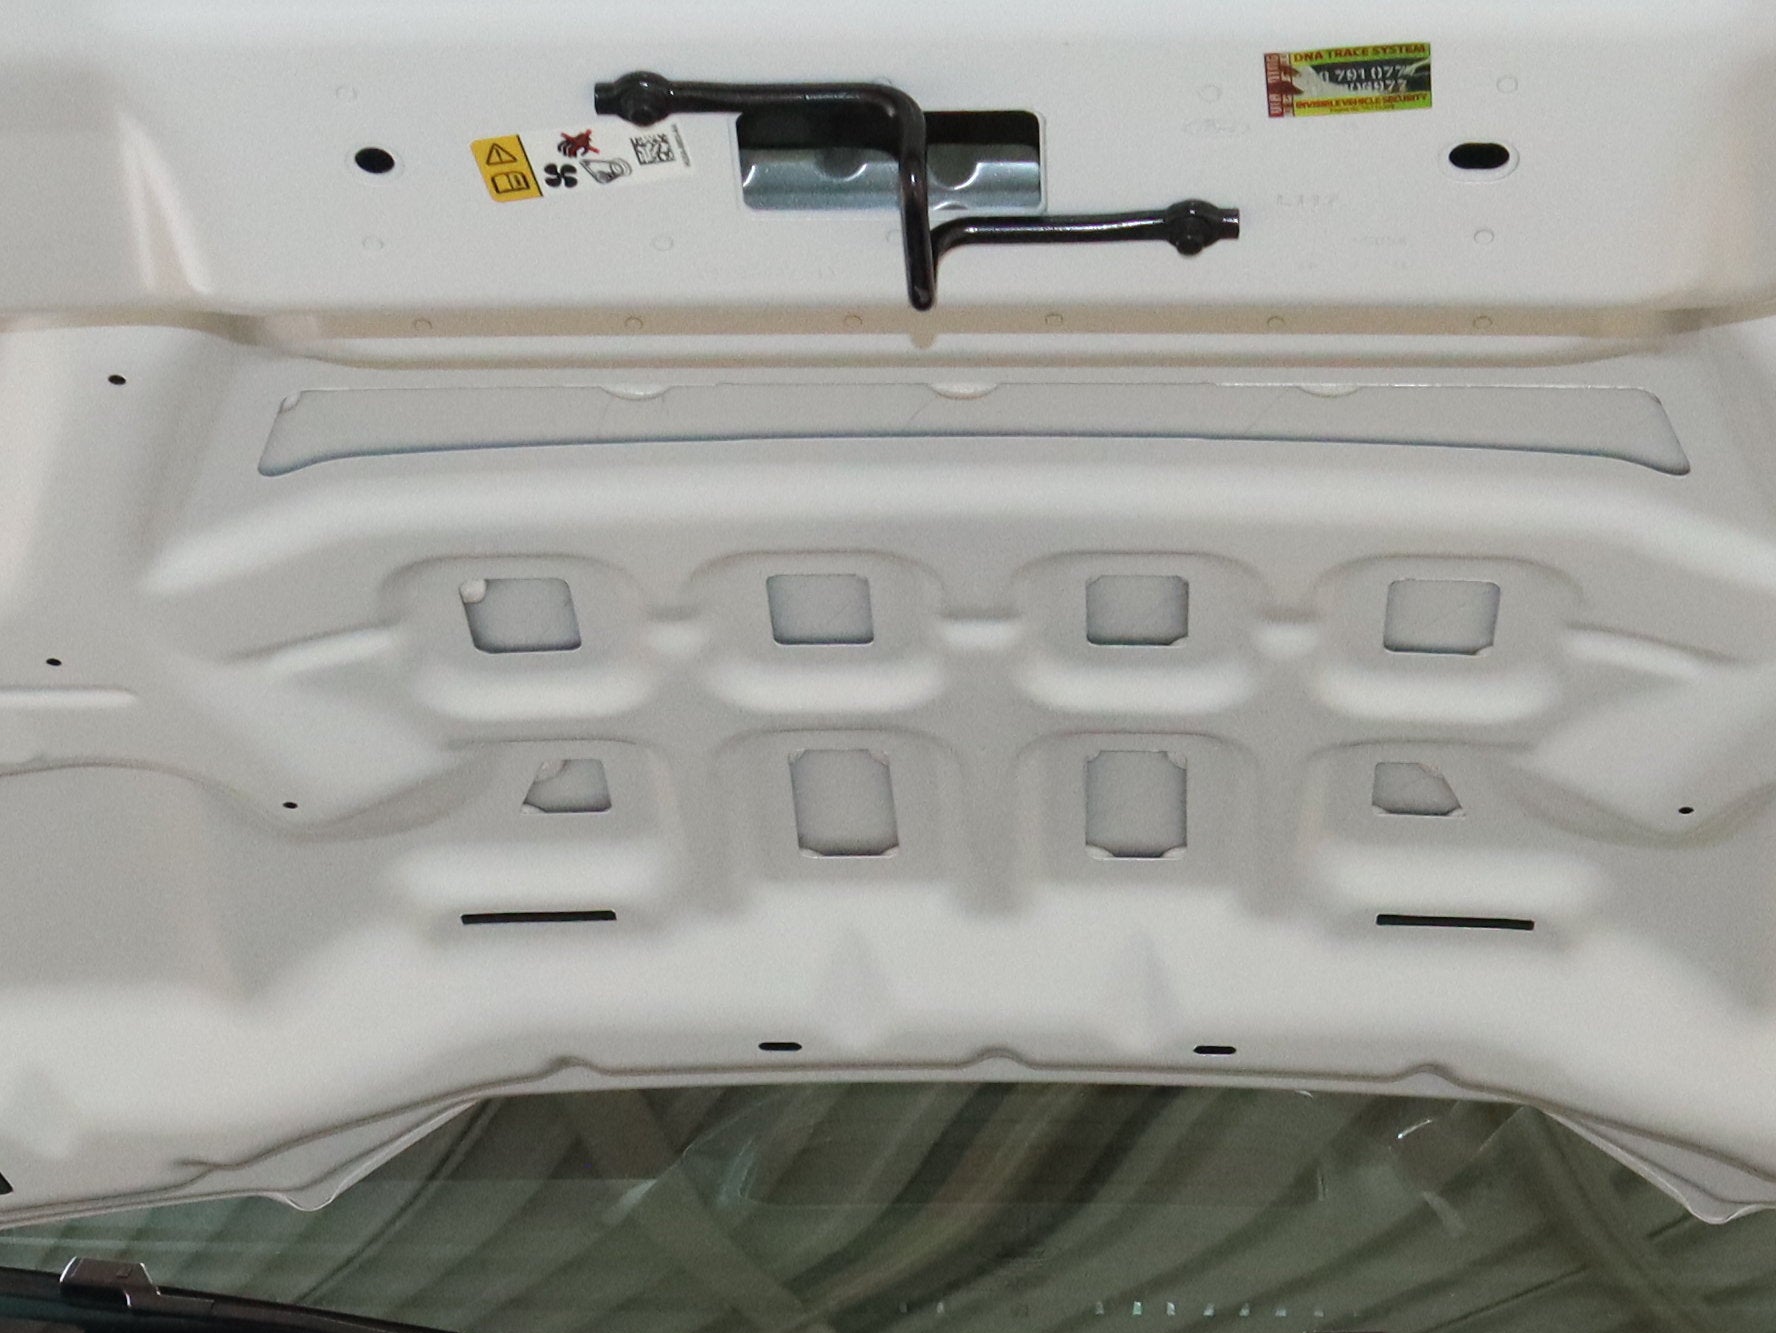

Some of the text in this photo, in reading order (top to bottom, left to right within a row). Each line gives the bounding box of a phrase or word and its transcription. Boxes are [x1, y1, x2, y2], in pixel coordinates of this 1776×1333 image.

[1294, 44, 1426, 62] DNA TRACE SYSTEM
